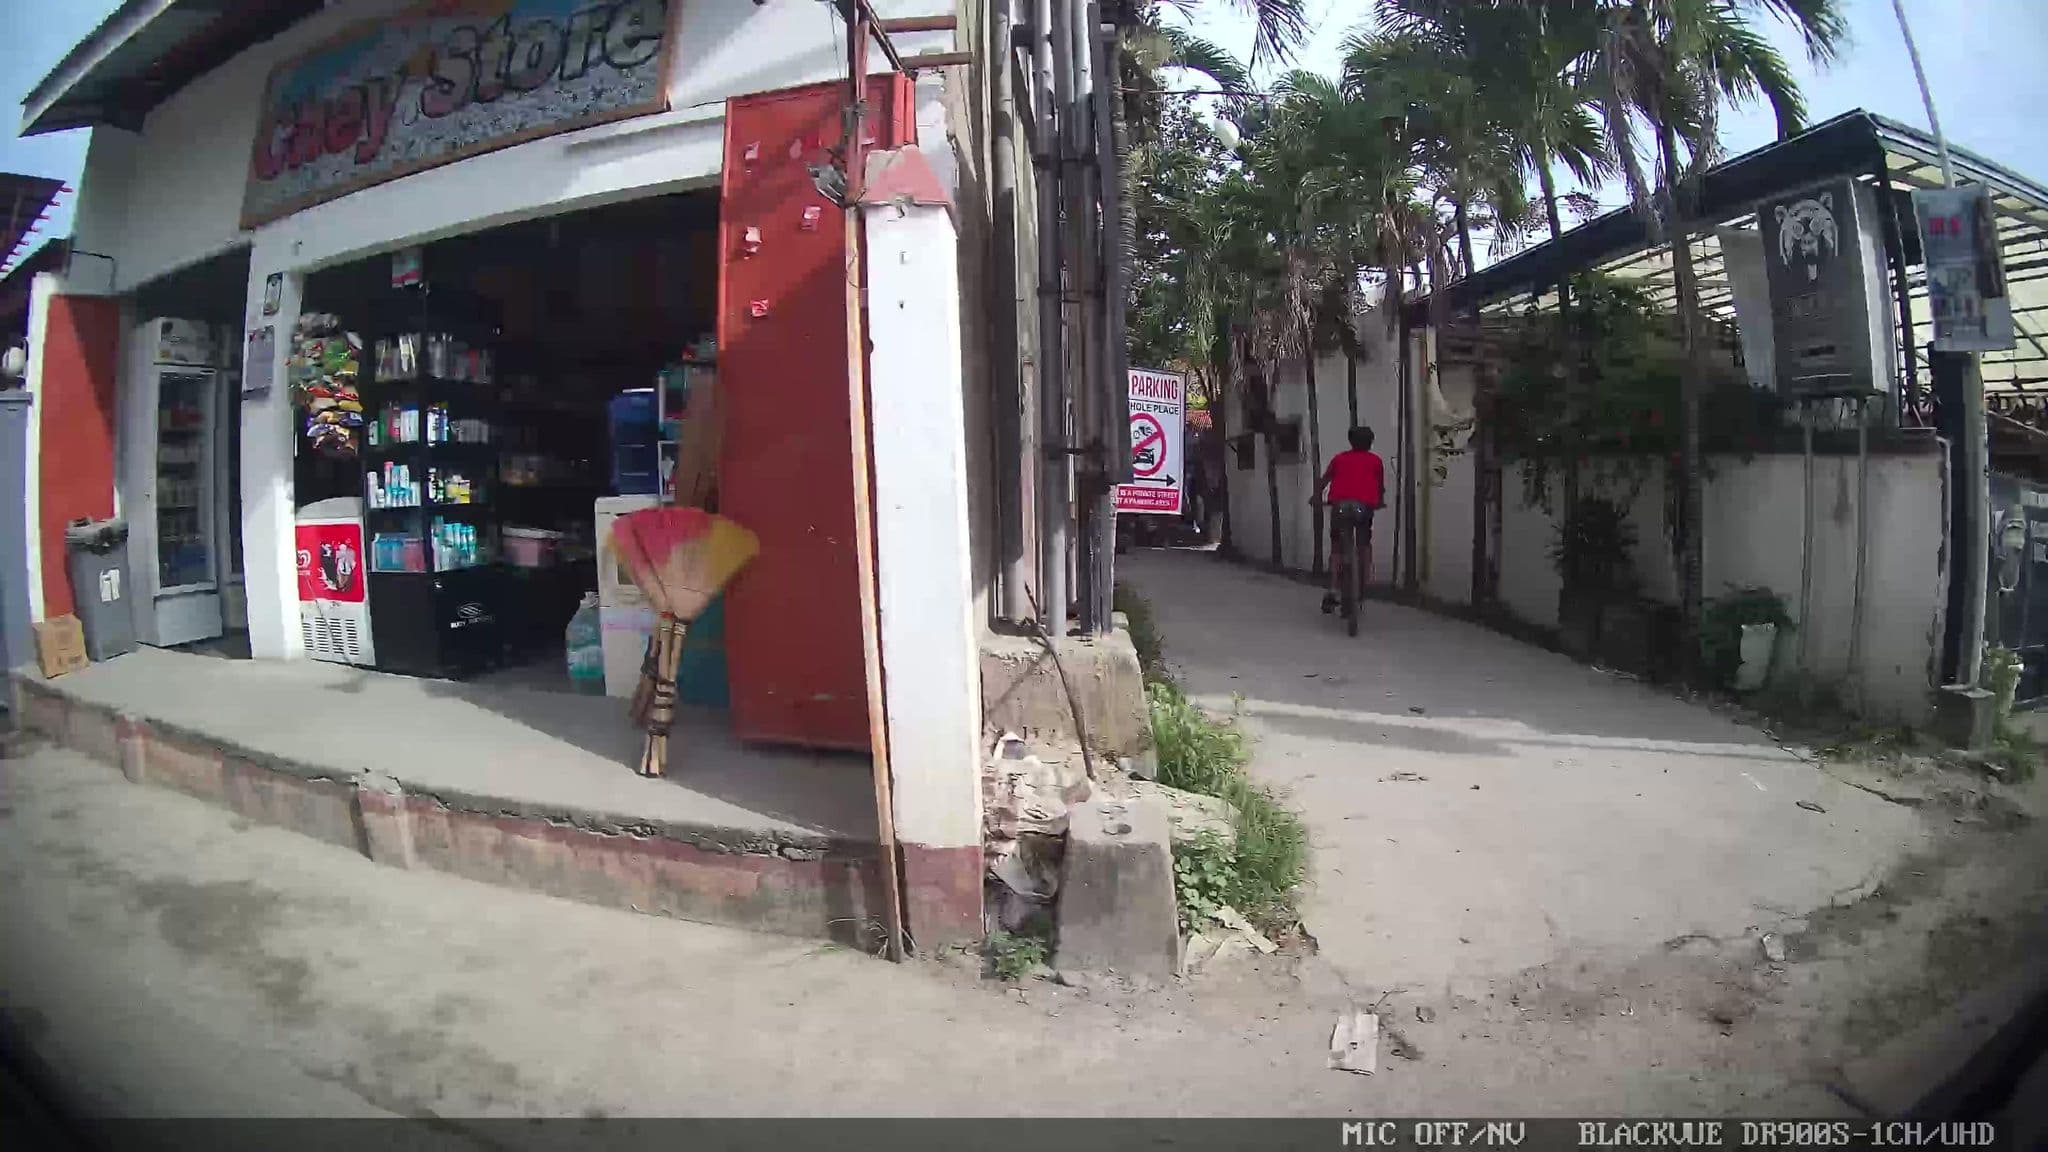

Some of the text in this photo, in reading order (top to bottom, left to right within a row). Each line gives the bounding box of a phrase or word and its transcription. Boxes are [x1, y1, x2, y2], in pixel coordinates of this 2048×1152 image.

[419, 0, 666, 118] Store
[1131, 375, 1178, 400] PARKING
[1130, 401, 1179, 415] HOLE PLACE
